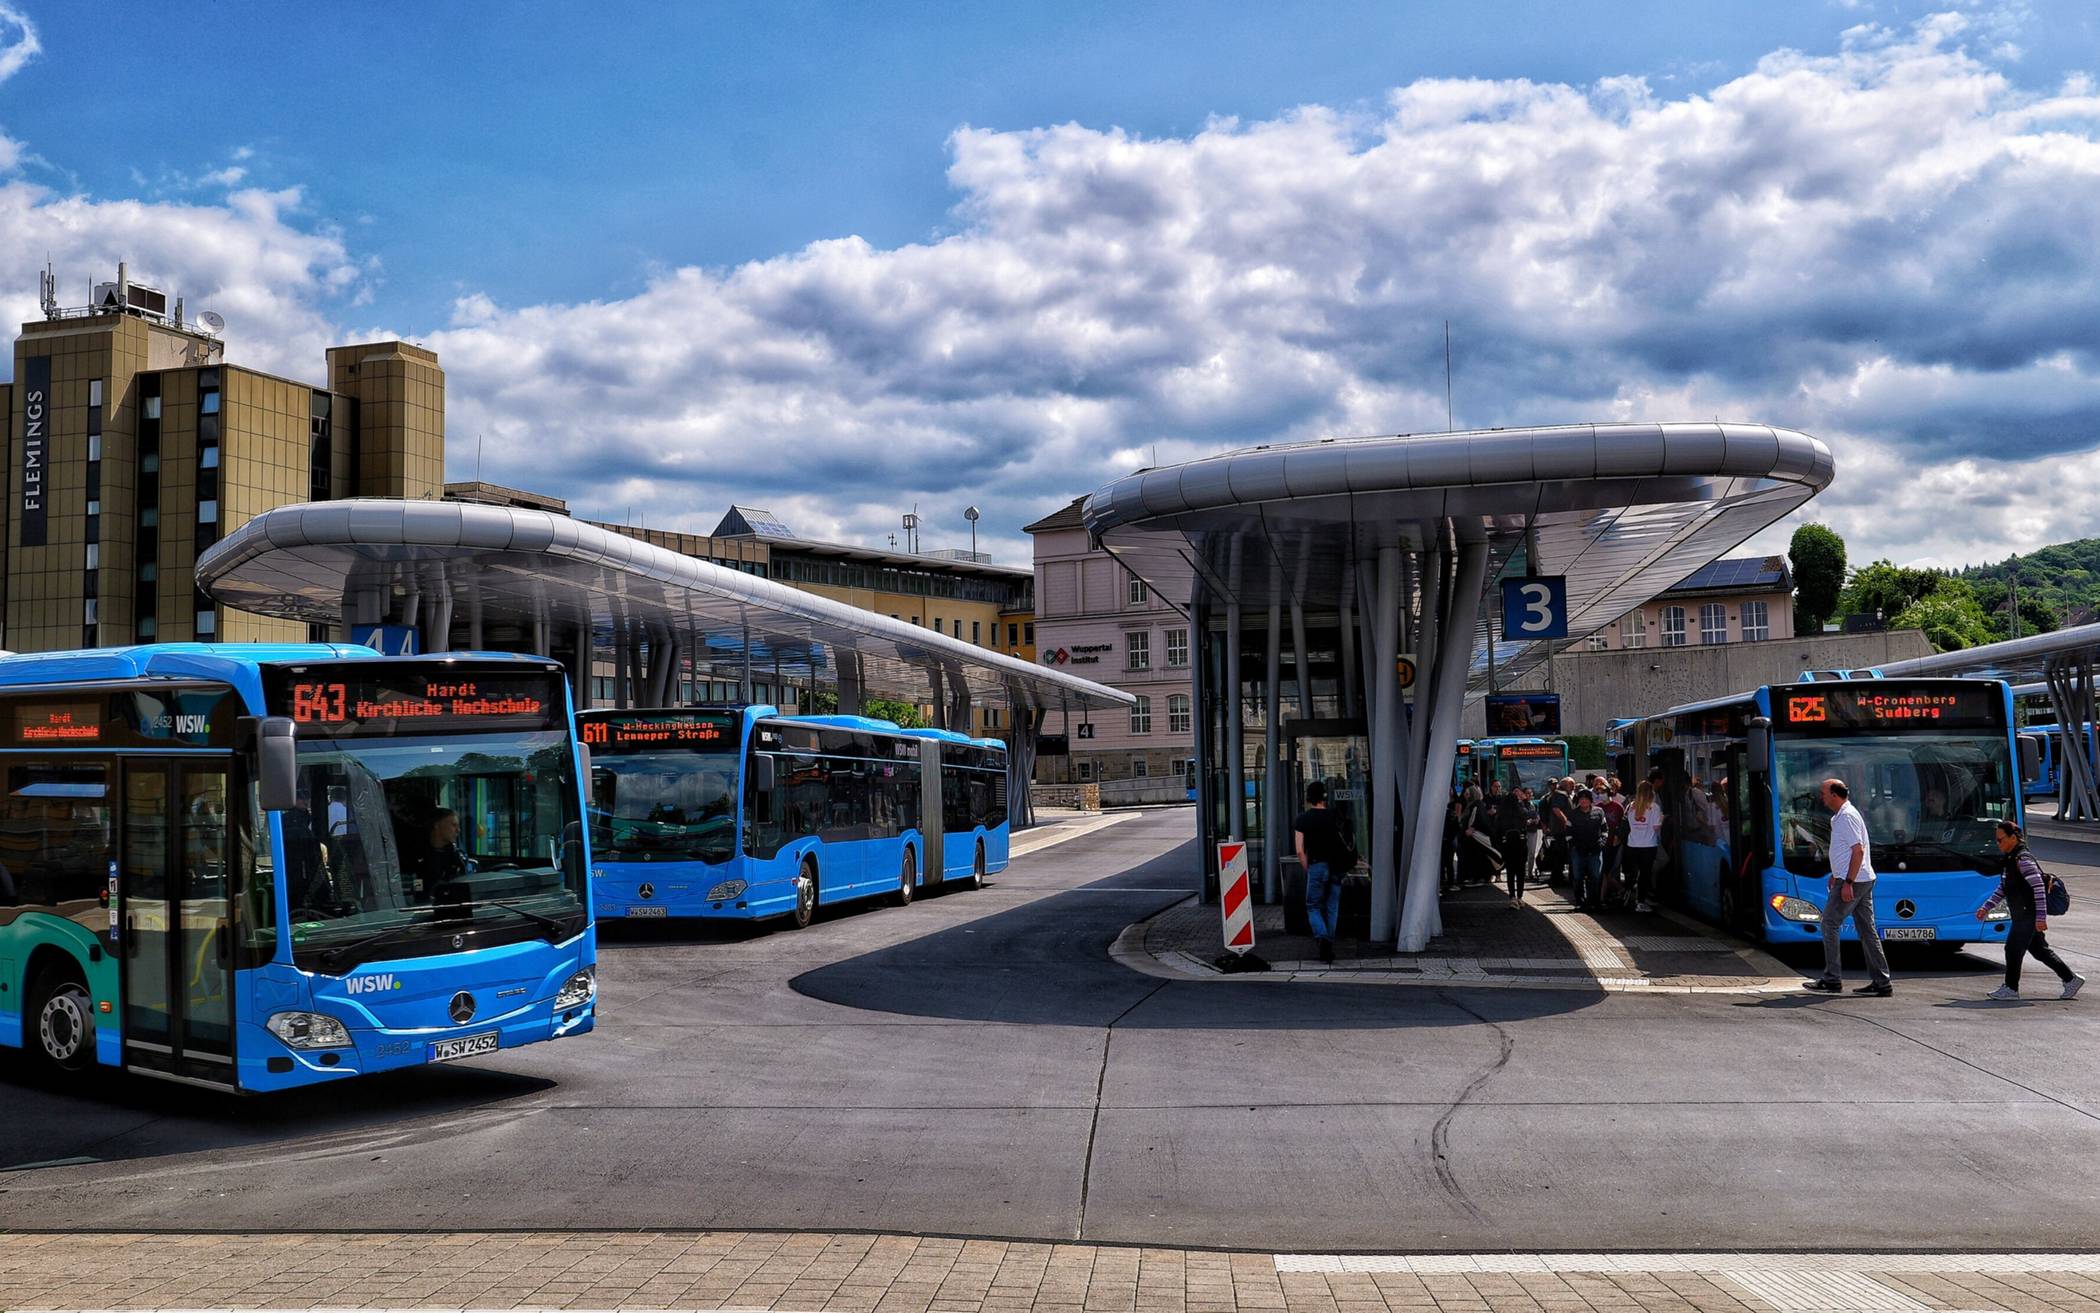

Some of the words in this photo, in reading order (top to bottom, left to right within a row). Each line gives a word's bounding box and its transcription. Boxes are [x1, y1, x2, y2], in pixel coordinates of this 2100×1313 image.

[25, 390, 43, 510] FLEMINGS
[1520, 583, 1552, 632] 3
[365, 628, 385, 656] 4
[400, 630, 413, 656] 4
[1071, 644, 1112, 653] Wuppertal
[1071, 656, 1099, 664] Institut
[427, 683, 476, 697] Hardt
[294, 684, 345, 722] 643
[357, 701, 442, 718] Kirchliche
[453, 698, 541, 715] Hochschule
[1789, 697, 1825, 722] 625
[1857, 696, 1955, 705] W-Cronenberg
[1875, 707, 1940, 718] Sudberg
[154, 716, 172, 728] 2452
[584, 723, 608, 743] 611
[617, 731, 669, 741] Lenneper
[678, 730, 720, 740] Straße
[1080, 725, 1089, 738] 4
[376, 1041, 410, 1059] 2452
